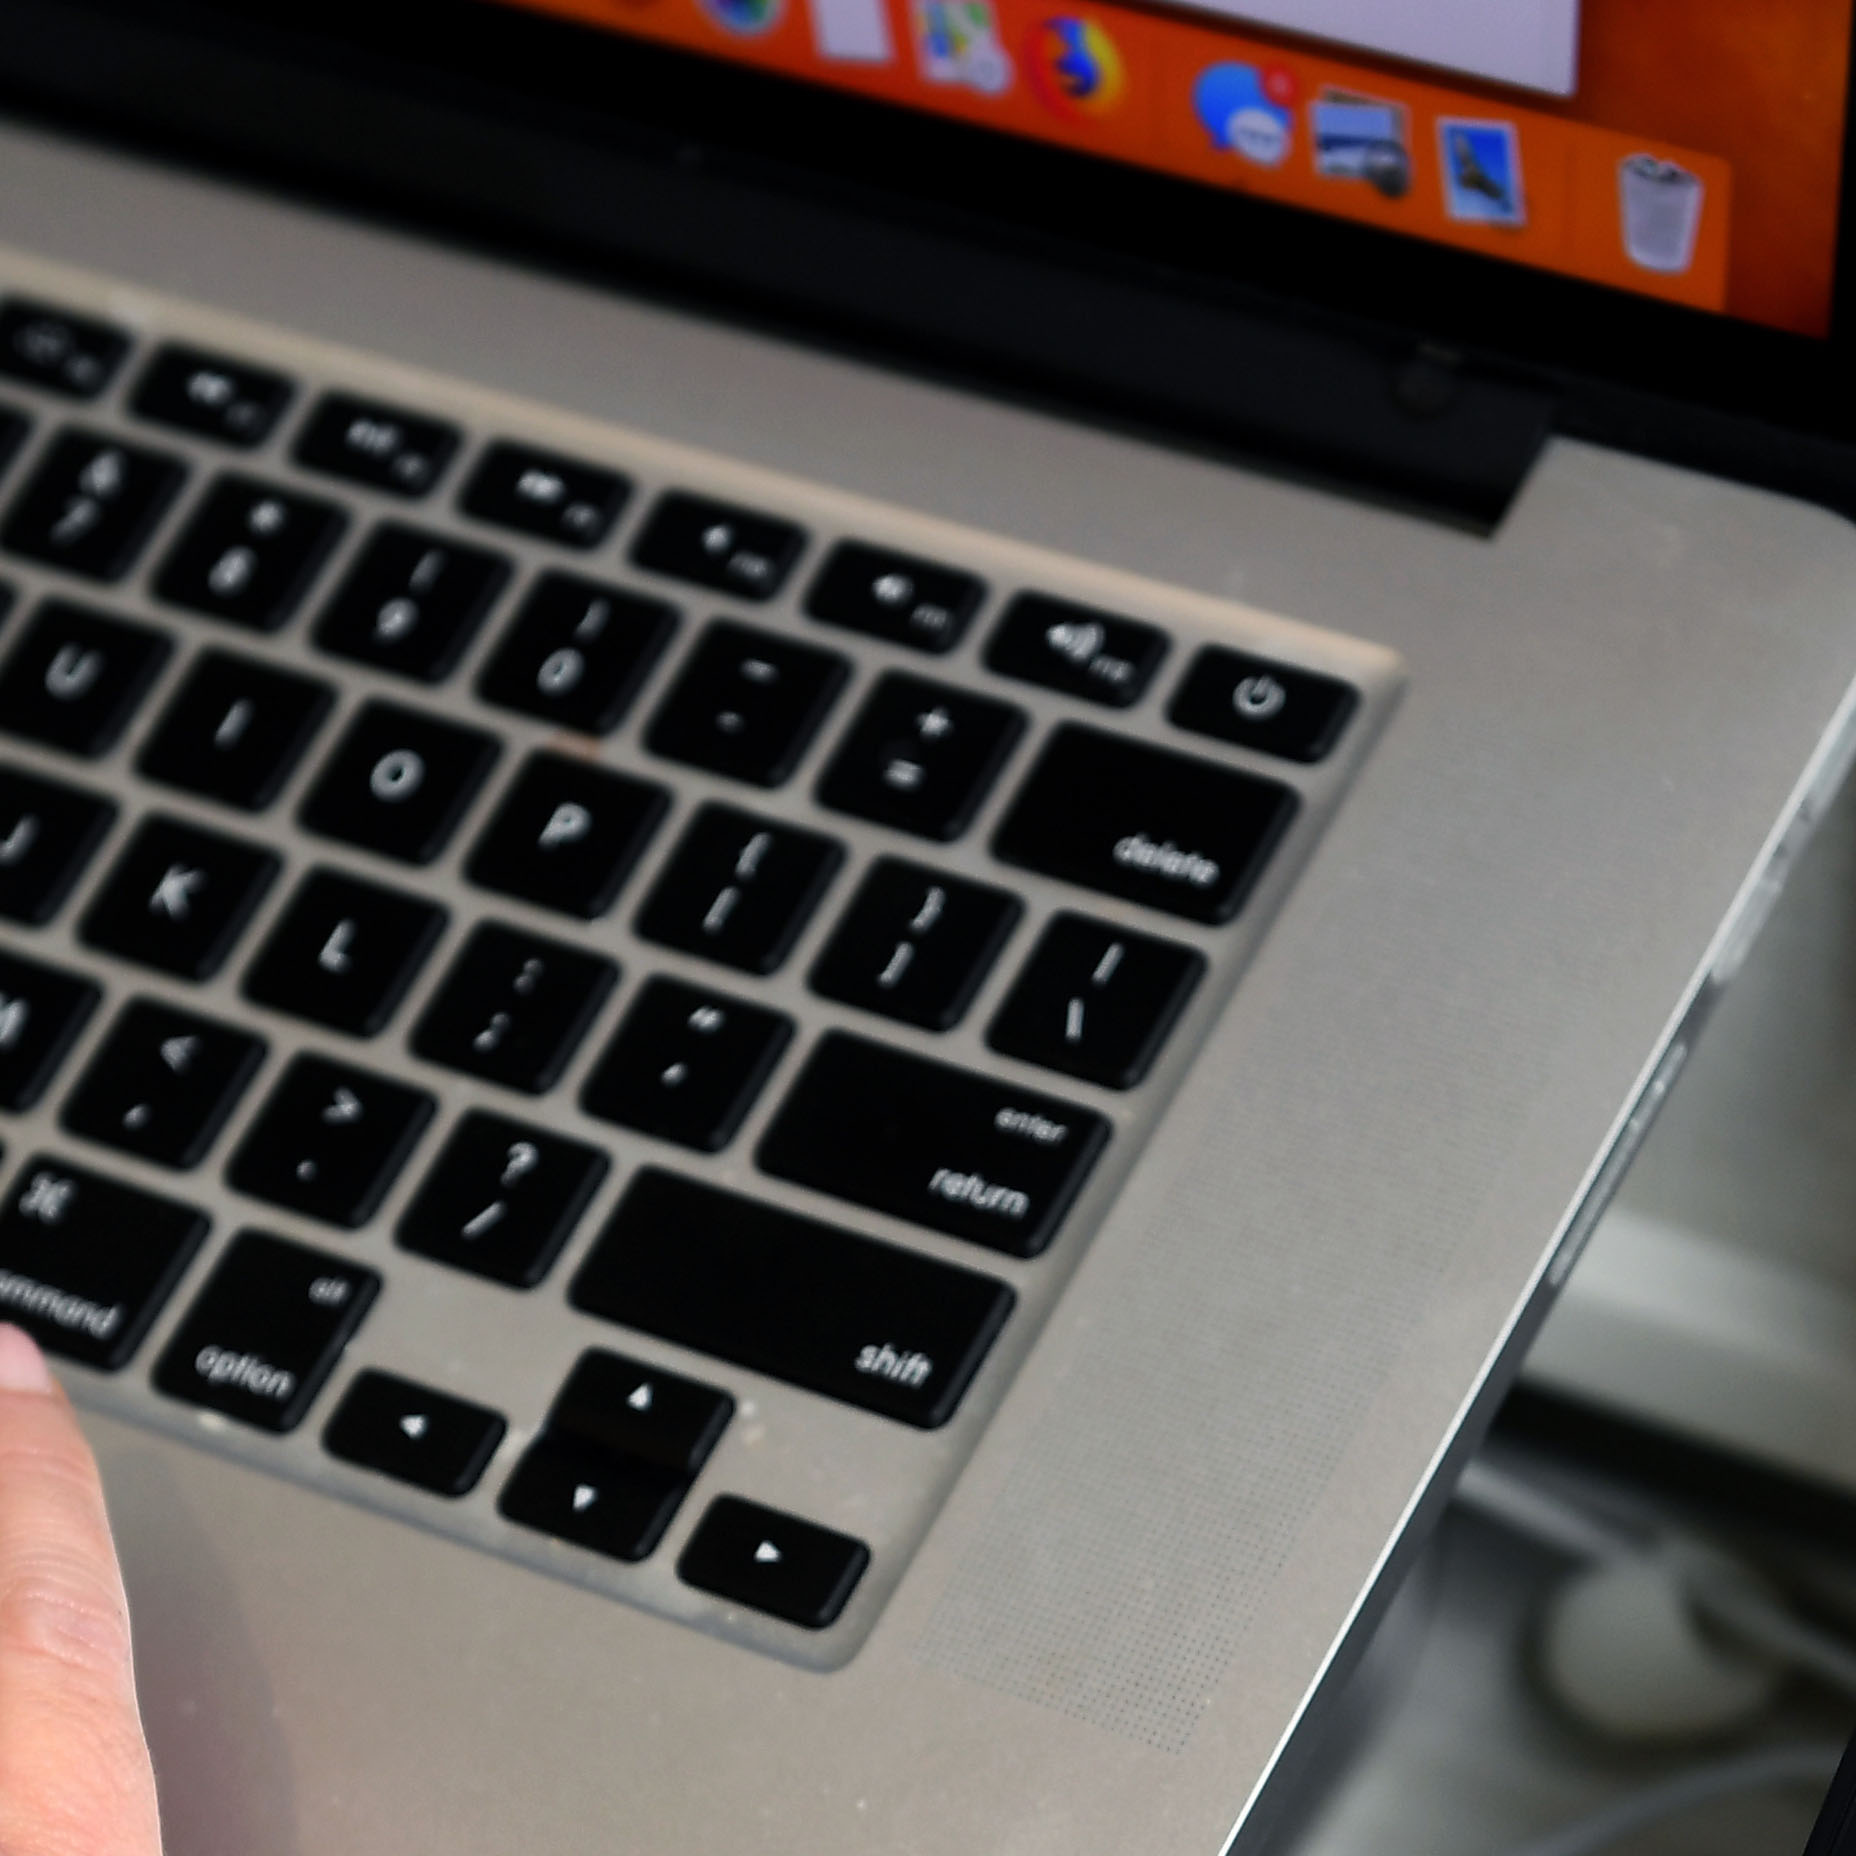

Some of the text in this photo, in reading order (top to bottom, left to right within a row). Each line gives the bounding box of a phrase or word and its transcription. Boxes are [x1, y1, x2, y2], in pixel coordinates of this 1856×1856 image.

[44, 646, 98, 696] U
[369, 749, 423, 799] O
[539, 802, 589, 844] P
[151, 867, 197, 914] K
[318, 921, 351, 971] L
[927, 1164, 1032, 1220] return
[193, 1342, 296, 1400] option
[854, 1340, 936, 1389] shift
